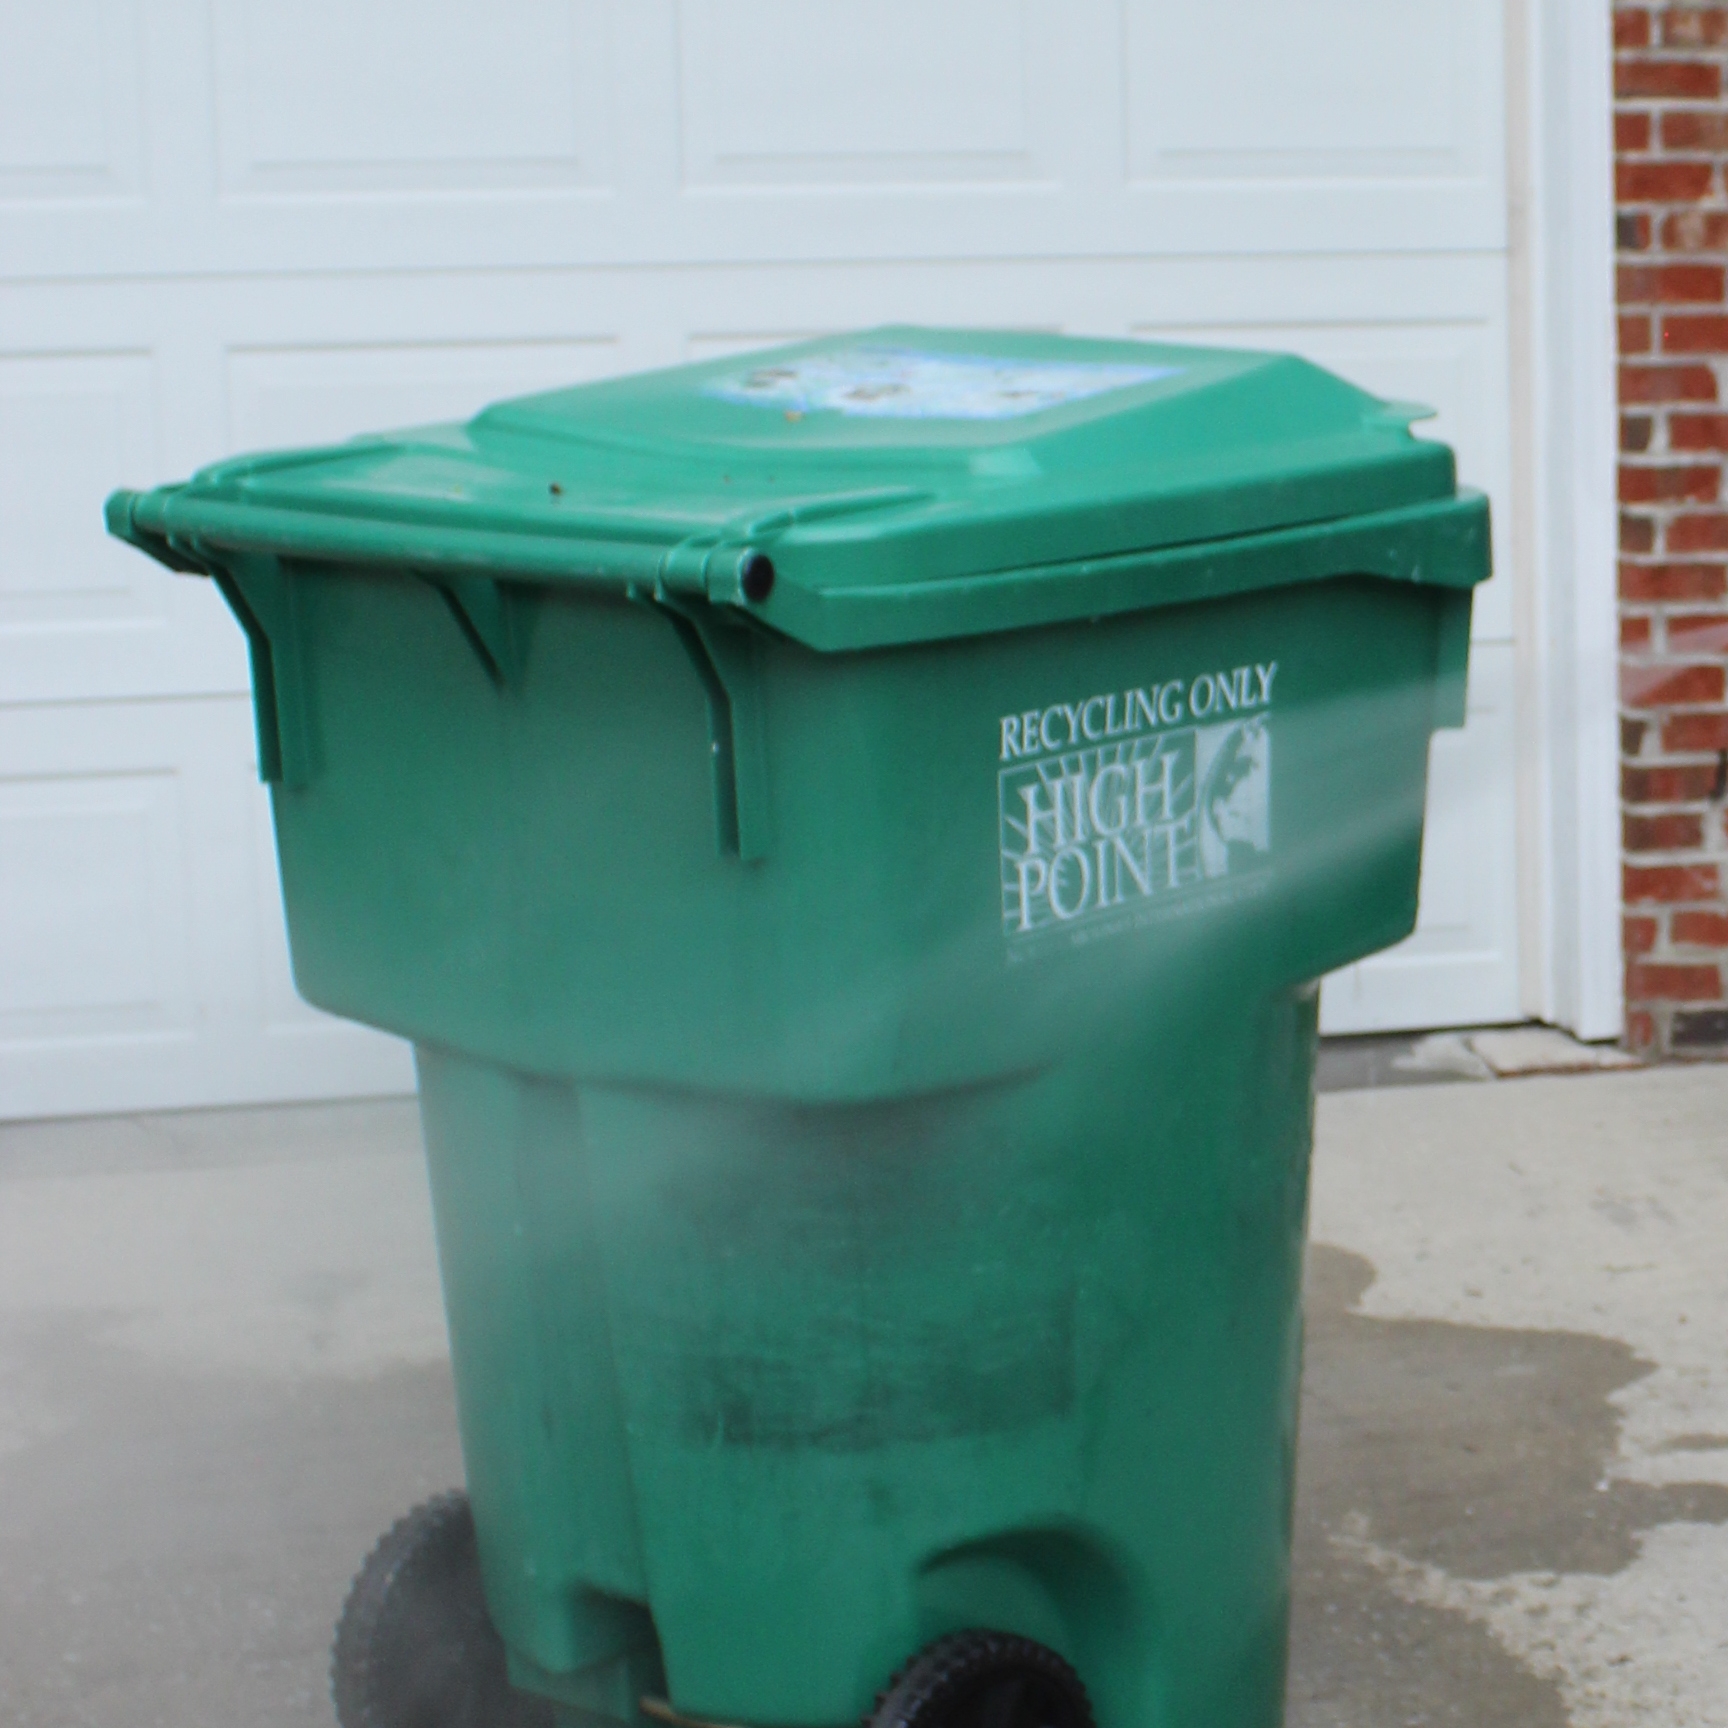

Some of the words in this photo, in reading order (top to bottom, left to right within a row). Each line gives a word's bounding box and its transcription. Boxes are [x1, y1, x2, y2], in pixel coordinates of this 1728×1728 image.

[1000, 679, 1185, 761] RECYCLING
[1189, 659, 1278, 719] ONLY
[1017, 748, 1182, 857] HIGH
[1013, 819, 1192, 932] POINT
